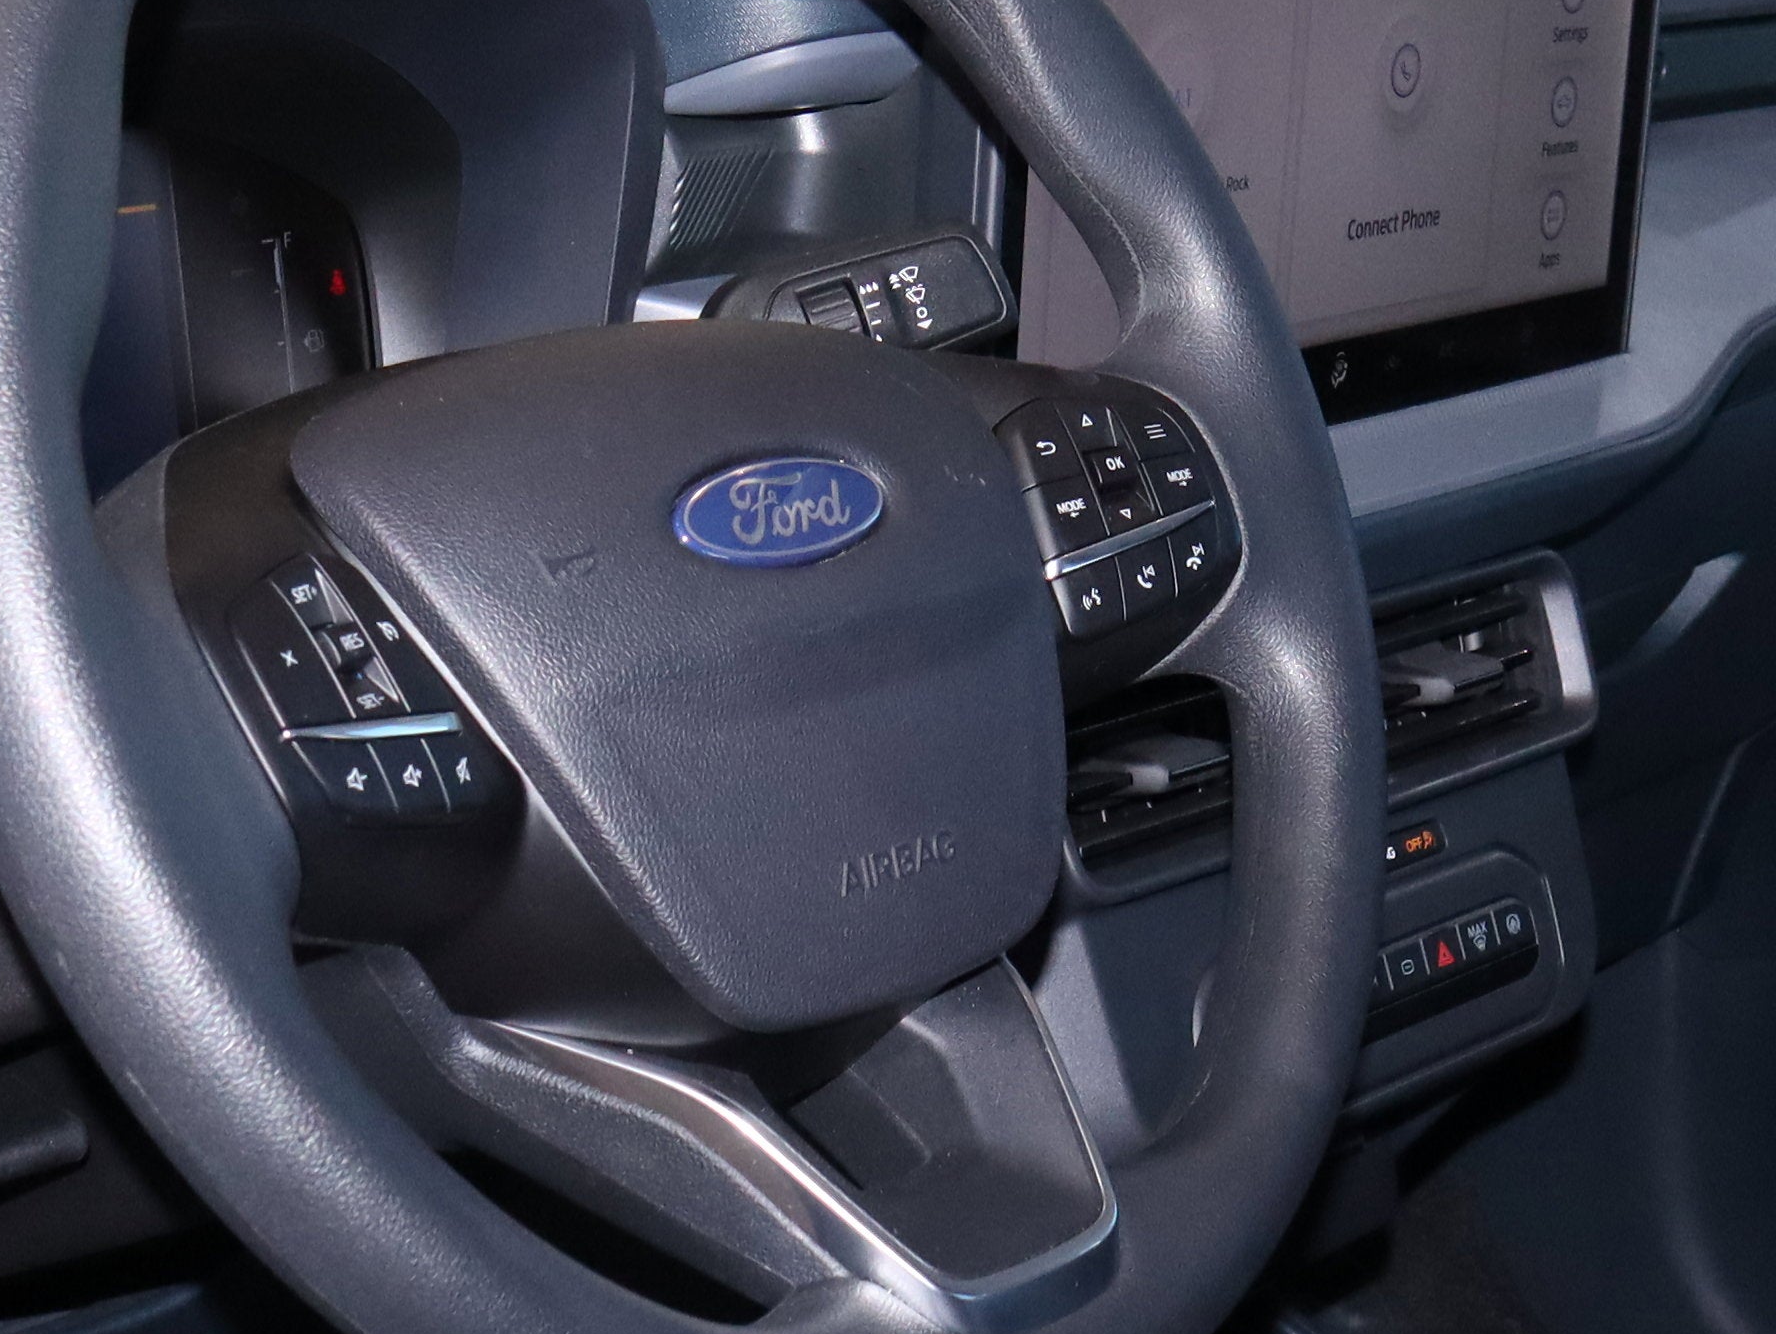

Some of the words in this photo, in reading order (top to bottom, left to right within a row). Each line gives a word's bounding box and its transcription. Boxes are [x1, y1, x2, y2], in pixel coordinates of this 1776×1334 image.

[1552, 27, 1589, 44] Settings
[1541, 140, 1579, 158] Features
[1226, 175, 1250, 193] Rock
[1348, 213, 1399, 241] Connect
[1401, 208, 1441, 233] Phone
[283, 231, 292, 248] F
[1539, 252, 1561, 269] Apps
[1105, 455, 1126, 472] OK
[1166, 468, 1194, 483] MODE
[729, 471, 851, 546] Ford
[1056, 497, 1087, 515] MODE
[339, 632, 365, 652] RES
[1405, 835, 1423, 853] OFF
[836, 829, 956, 899] AIRBAG
[1467, 921, 1489, 939] MAX
